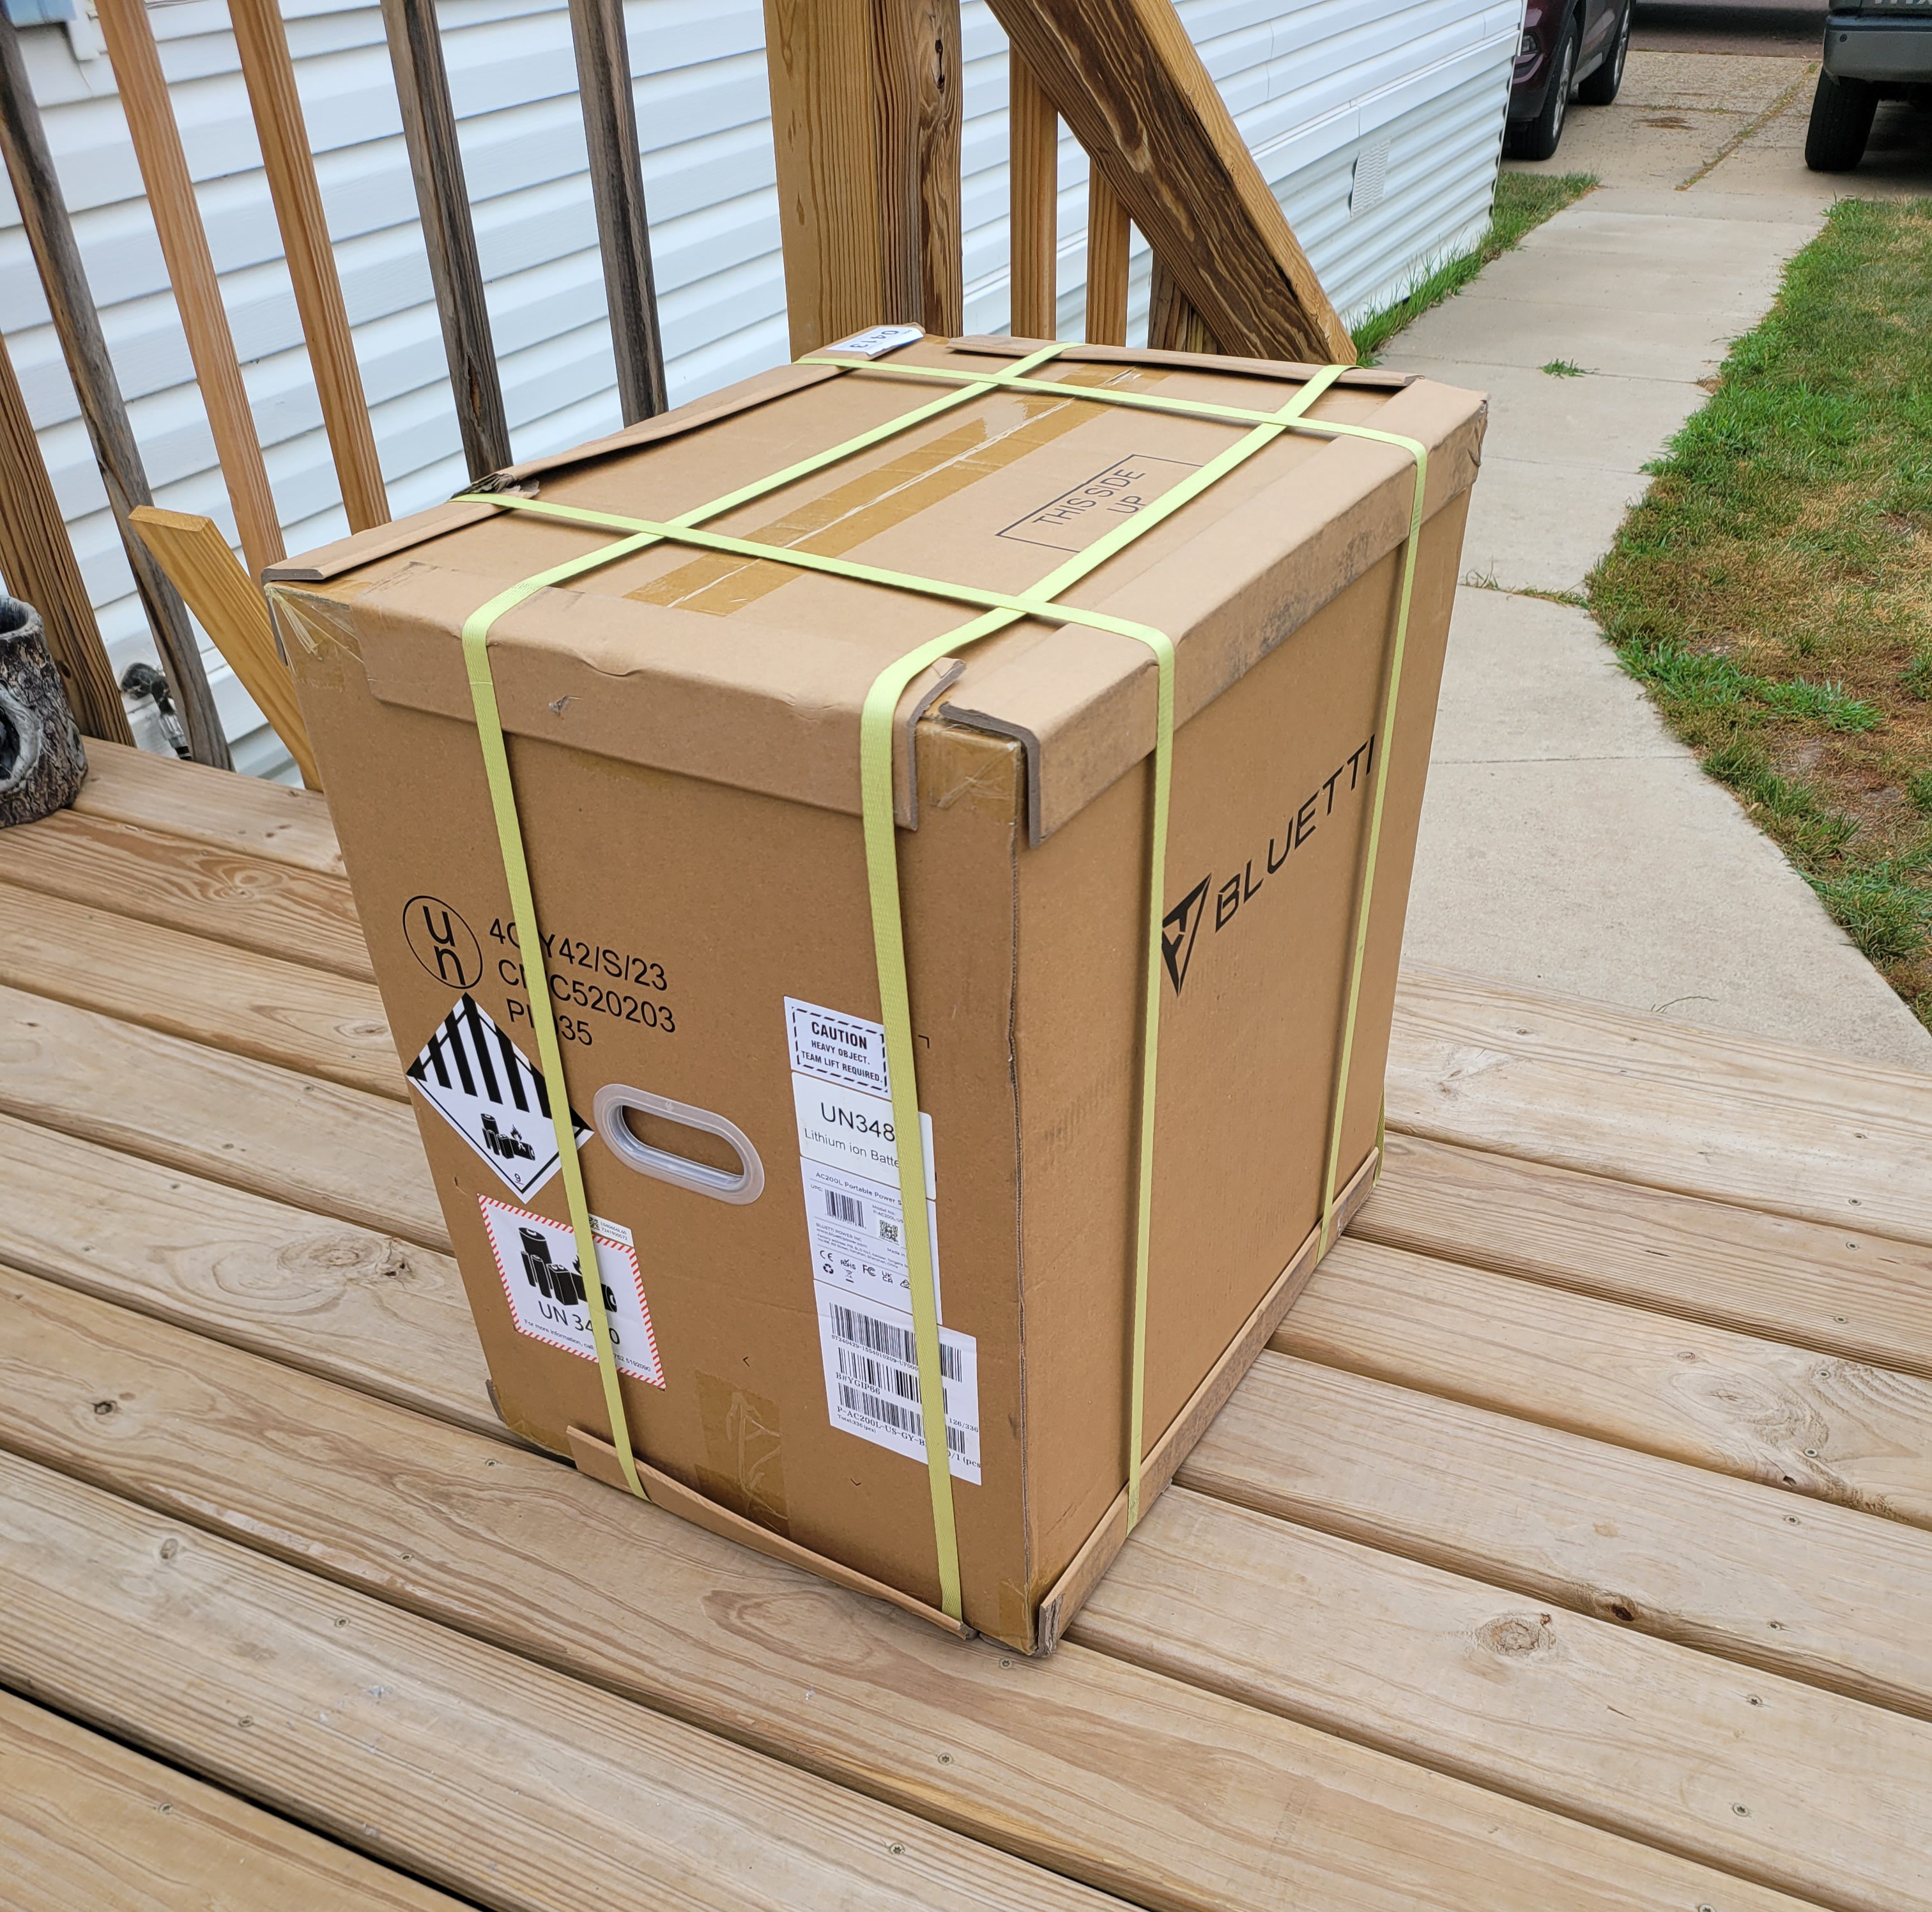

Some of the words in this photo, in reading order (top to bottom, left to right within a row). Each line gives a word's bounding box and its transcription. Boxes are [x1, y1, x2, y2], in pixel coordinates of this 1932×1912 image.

[849, 330, 900, 348] 0413
[1032, 498, 1097, 525] THIS
[1084, 469, 1146, 497] SIDE
[1106, 495, 1147, 514] UP
[1215, 733, 1376, 934] BLUETTI
[498, 959, 676, 1033] CC520203
[811, 1021, 868, 1050] CAUTION
[801, 1051, 822, 1065] TEAM
[824, 1058, 841, 1069] LIFT
[842, 1063, 883, 1083] REQUIRED.
[811, 1040, 836, 1054] HEAVY
[838, 1048, 870, 1065] OBJECT.
[820, 1102, 896, 1142] UN348
[804, 1127, 846, 1151] Lithium
[850, 1143, 867, 1158] ion
[871, 1150, 900, 1168] Batte
[514, 1173, 521, 1182] 9
[816, 1172, 843, 1186] AC200L
[845, 1182, 873, 1196] Portable
[874, 1192, 896, 1204] Power
[816, 1222, 835, 1233] BLUETTI
[835, 1229, 854, 1238] POWER
[524, 1318, 535, 1327] For
[535, 1323, 549, 1333] more
[538, 1300, 569, 1326] UN
[572, 1314, 620, 1345] 340
[949, 1417, 979, 1433] 126/336
